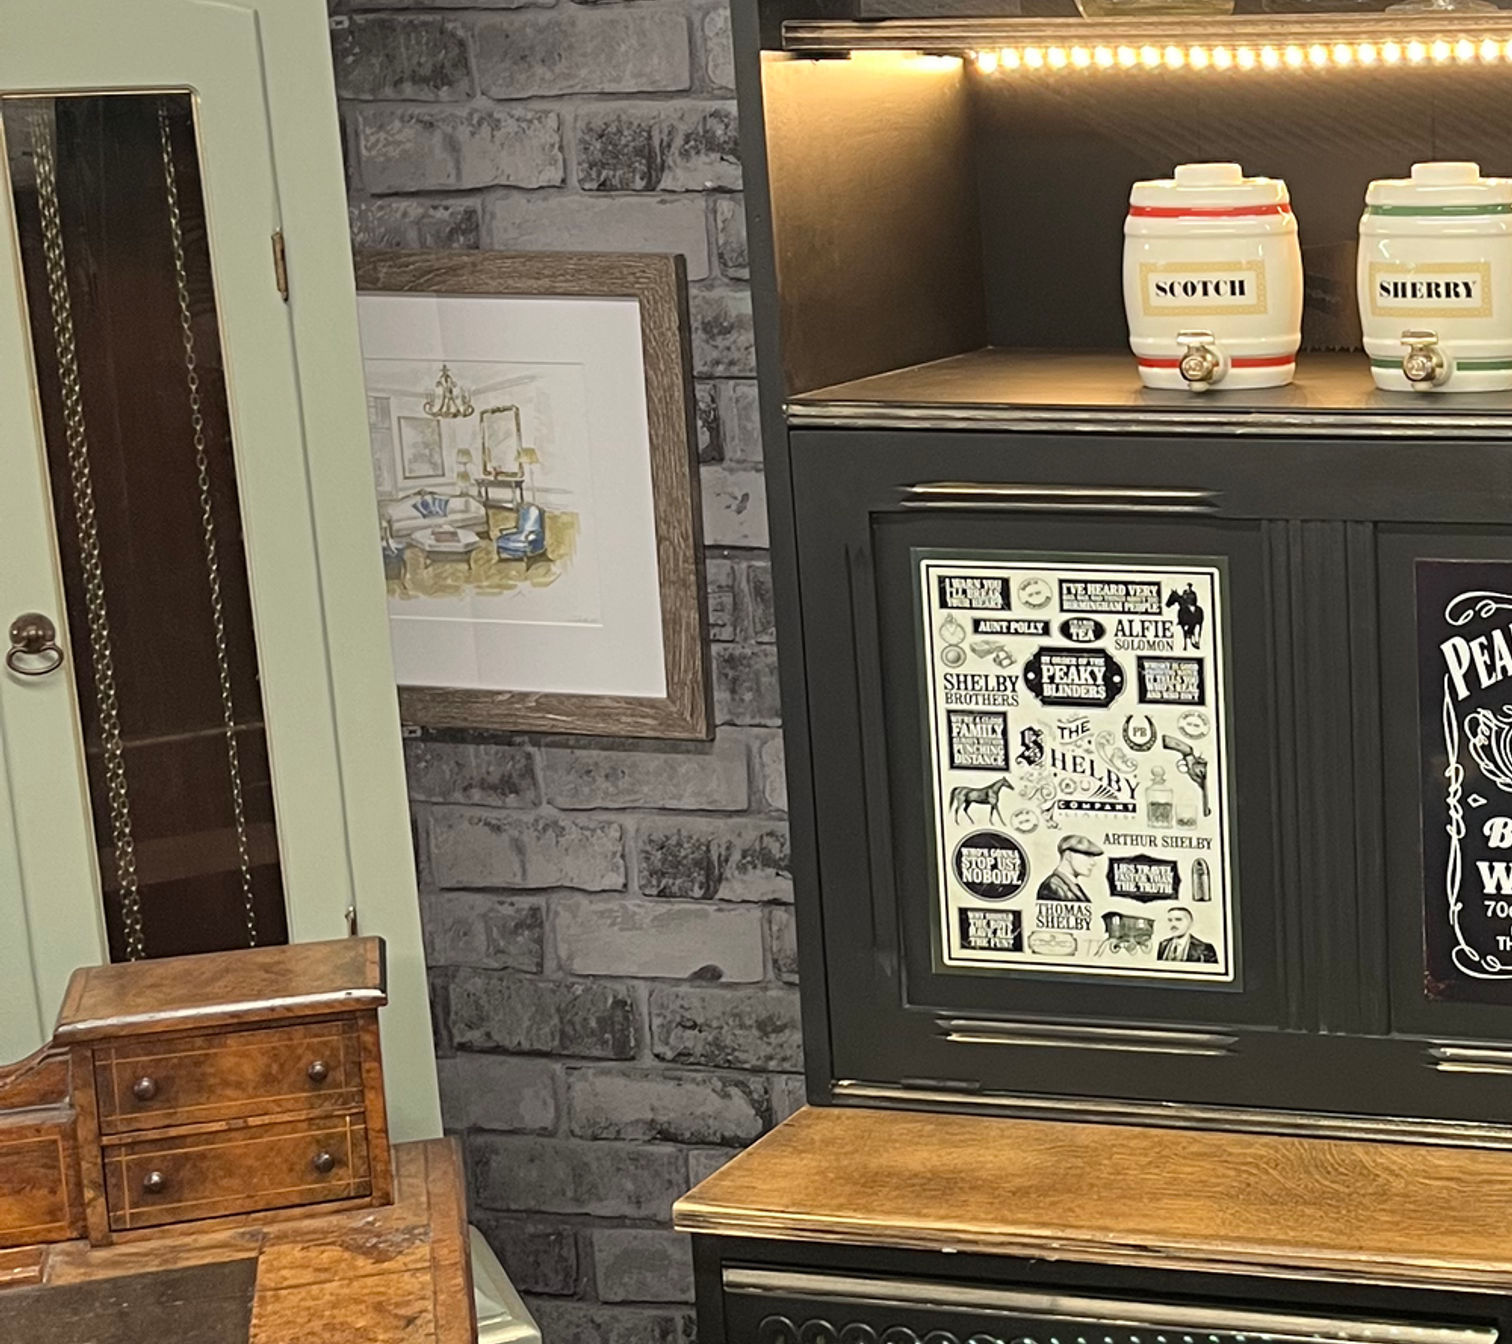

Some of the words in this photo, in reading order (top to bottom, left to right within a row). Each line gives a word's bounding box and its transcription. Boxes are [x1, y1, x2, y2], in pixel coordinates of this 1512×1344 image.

[1154, 279, 1247, 298] SCOTCH
[1379, 279, 1478, 300] SHERRY
[1087, 584, 1126, 596] HEARD
[1127, 585, 1158, 597] VERY
[978, 621, 1008, 632] AUNT
[1010, 621, 1045, 634] POLLY
[1070, 629, 1096, 641] TEA
[1114, 619, 1174, 638] ALFIE
[1114, 638, 1174, 652] SOLOMON
[943, 672, 1020, 692] SHELBY
[1041, 665, 1106, 685] PEAKY
[1043, 683, 1106, 699] BLINDERS
[944, 692, 1020, 707] BROTHERS
[952, 723, 1004, 738] FAMILY
[1057, 720, 1090, 740] THE
[1058, 801, 1135, 811] COMPANY
[1103, 833, 1158, 848] ARTHUR
[1161, 835, 1213, 850] SHELBY
[961, 856, 995, 869] STOP
[1036, 903, 1092, 917] THOMAS
[1036, 916, 1092, 931] SHELBY
